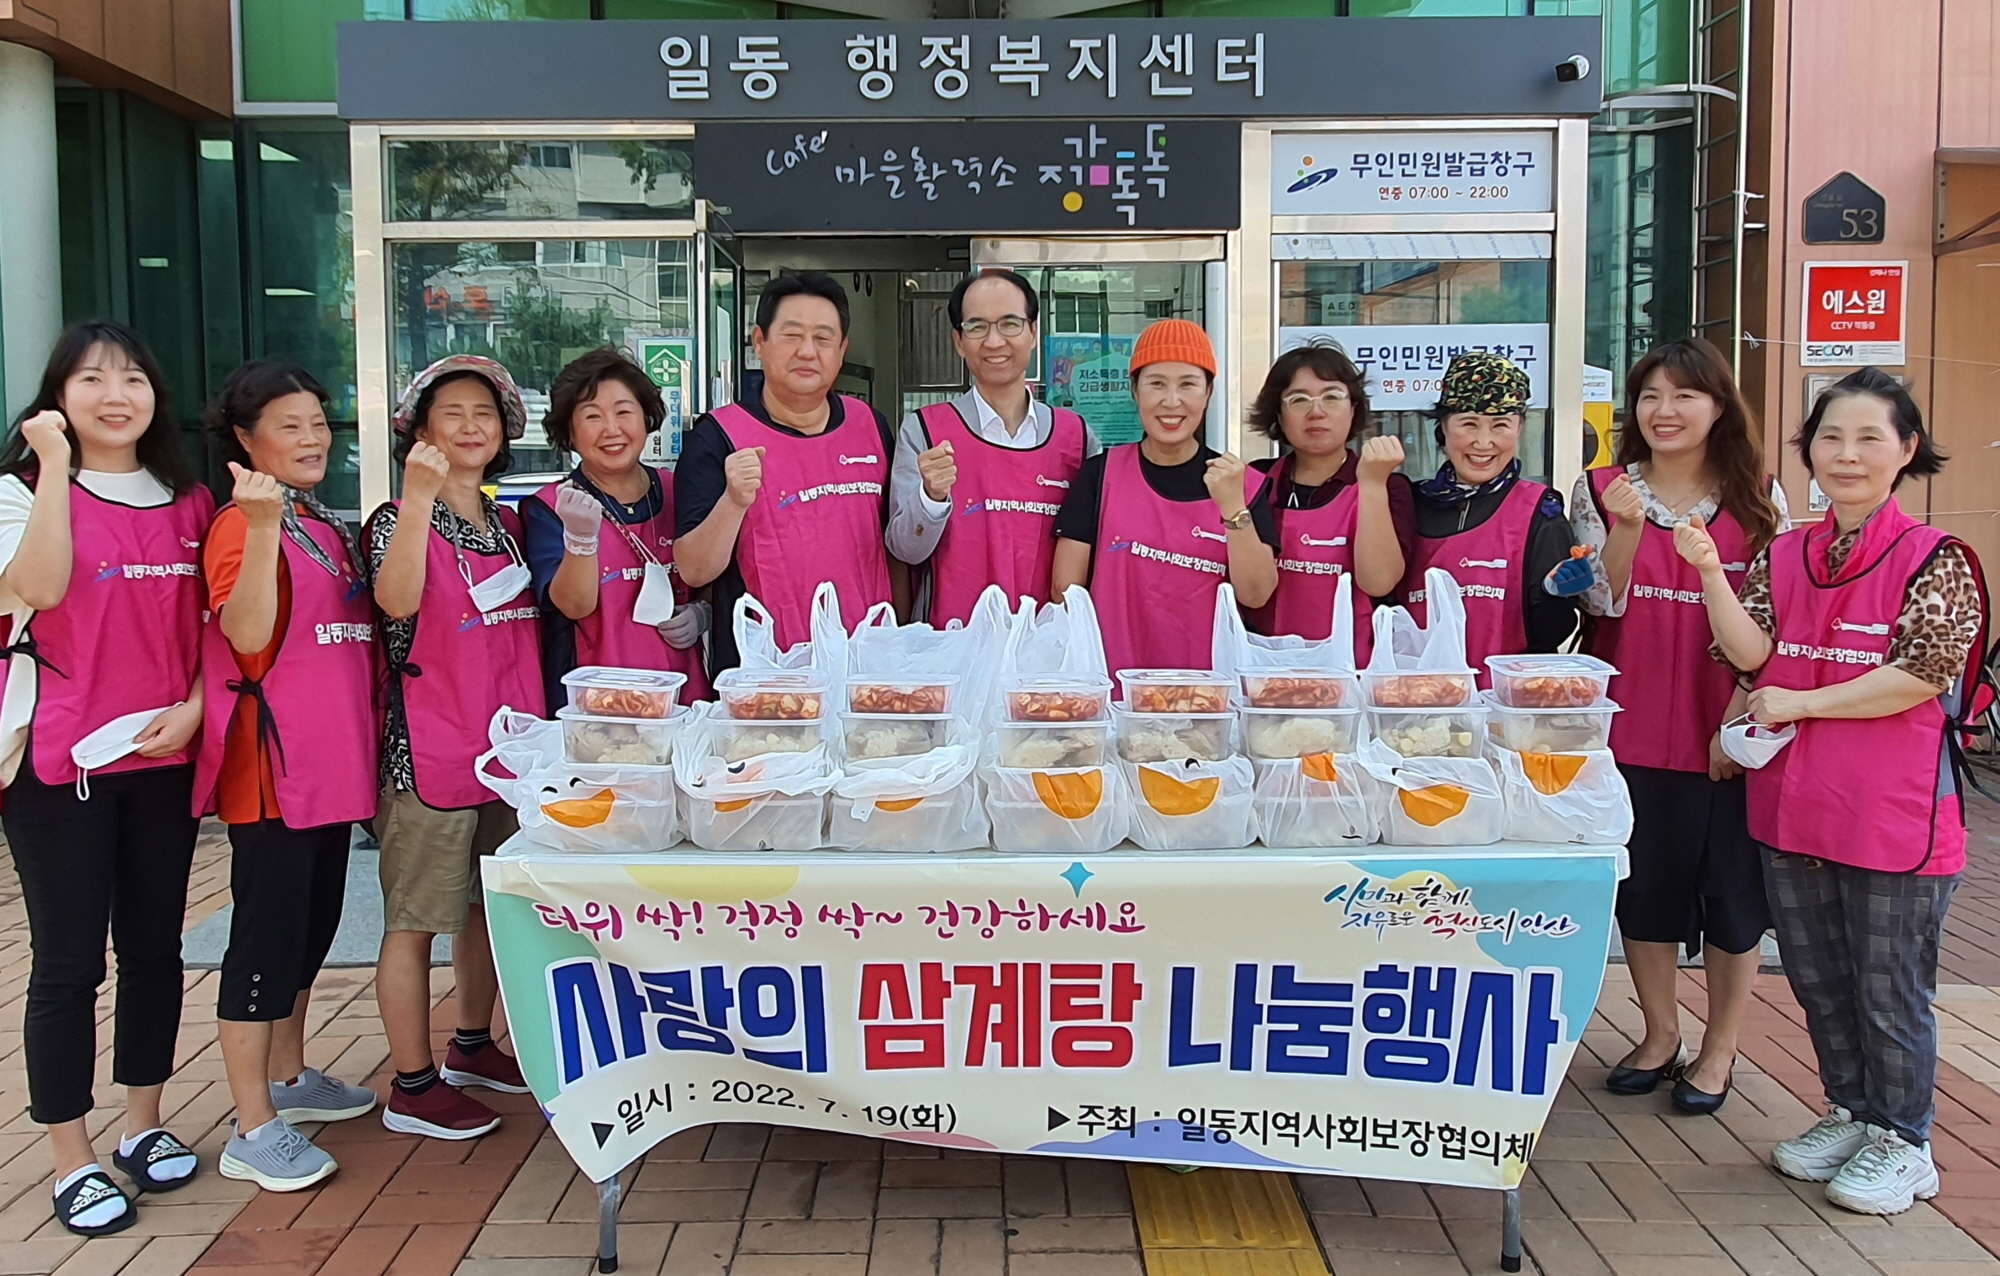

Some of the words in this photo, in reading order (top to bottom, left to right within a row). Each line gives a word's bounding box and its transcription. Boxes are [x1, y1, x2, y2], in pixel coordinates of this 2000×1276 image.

[659, 34, 790, 100] 일동
[846, 32, 1265, 100] 행정복지센터
[835, 146, 1017, 200] 마을활력소
[1350, 150, 1535, 178] 무인민원발급창구
[1378, 186, 1403, 201] 연중
[1409, 185, 1449, 199] 07:00
[1469, 185, 1509, 199] 22:00
[1840, 208, 1878, 239] 53
[1822, 289, 1886, 315] 에스원
[1830, 321, 1853, 330] CCTV
[1806, 344, 1853, 357] SECOM
[1382, 379, 1407, 394] 연중
[1324, 877, 1410, 915] 시민과
[534, 901, 623, 940] 더위
[636, 901, 703, 941] 싹!
[717, 900, 802, 940] 걱정
[917, 899, 1146, 940] 건강하세요
[1341, 911, 1416, 942] 자유로운
[1424, 910, 1516, 943] 혁신도시
[1521, 914, 1579, 936] 안산
[552, 961, 828, 1085] 사랑의
[859, 961, 1143, 1070] 삼계탕
[1168, 963, 1559, 1095] 나눔행사
[616, 1083, 673, 1134] 일시
[711, 1079, 806, 1110] 2022.
[817, 1097, 849, 1118] 7.
[862, 1102, 958, 1133] 19(화)
[1076, 1105, 1137, 1139] 주최
[1177, 1106, 1534, 1167] 일동지역사회보장협의체
[69, 1187, 119, 1214] adidas
